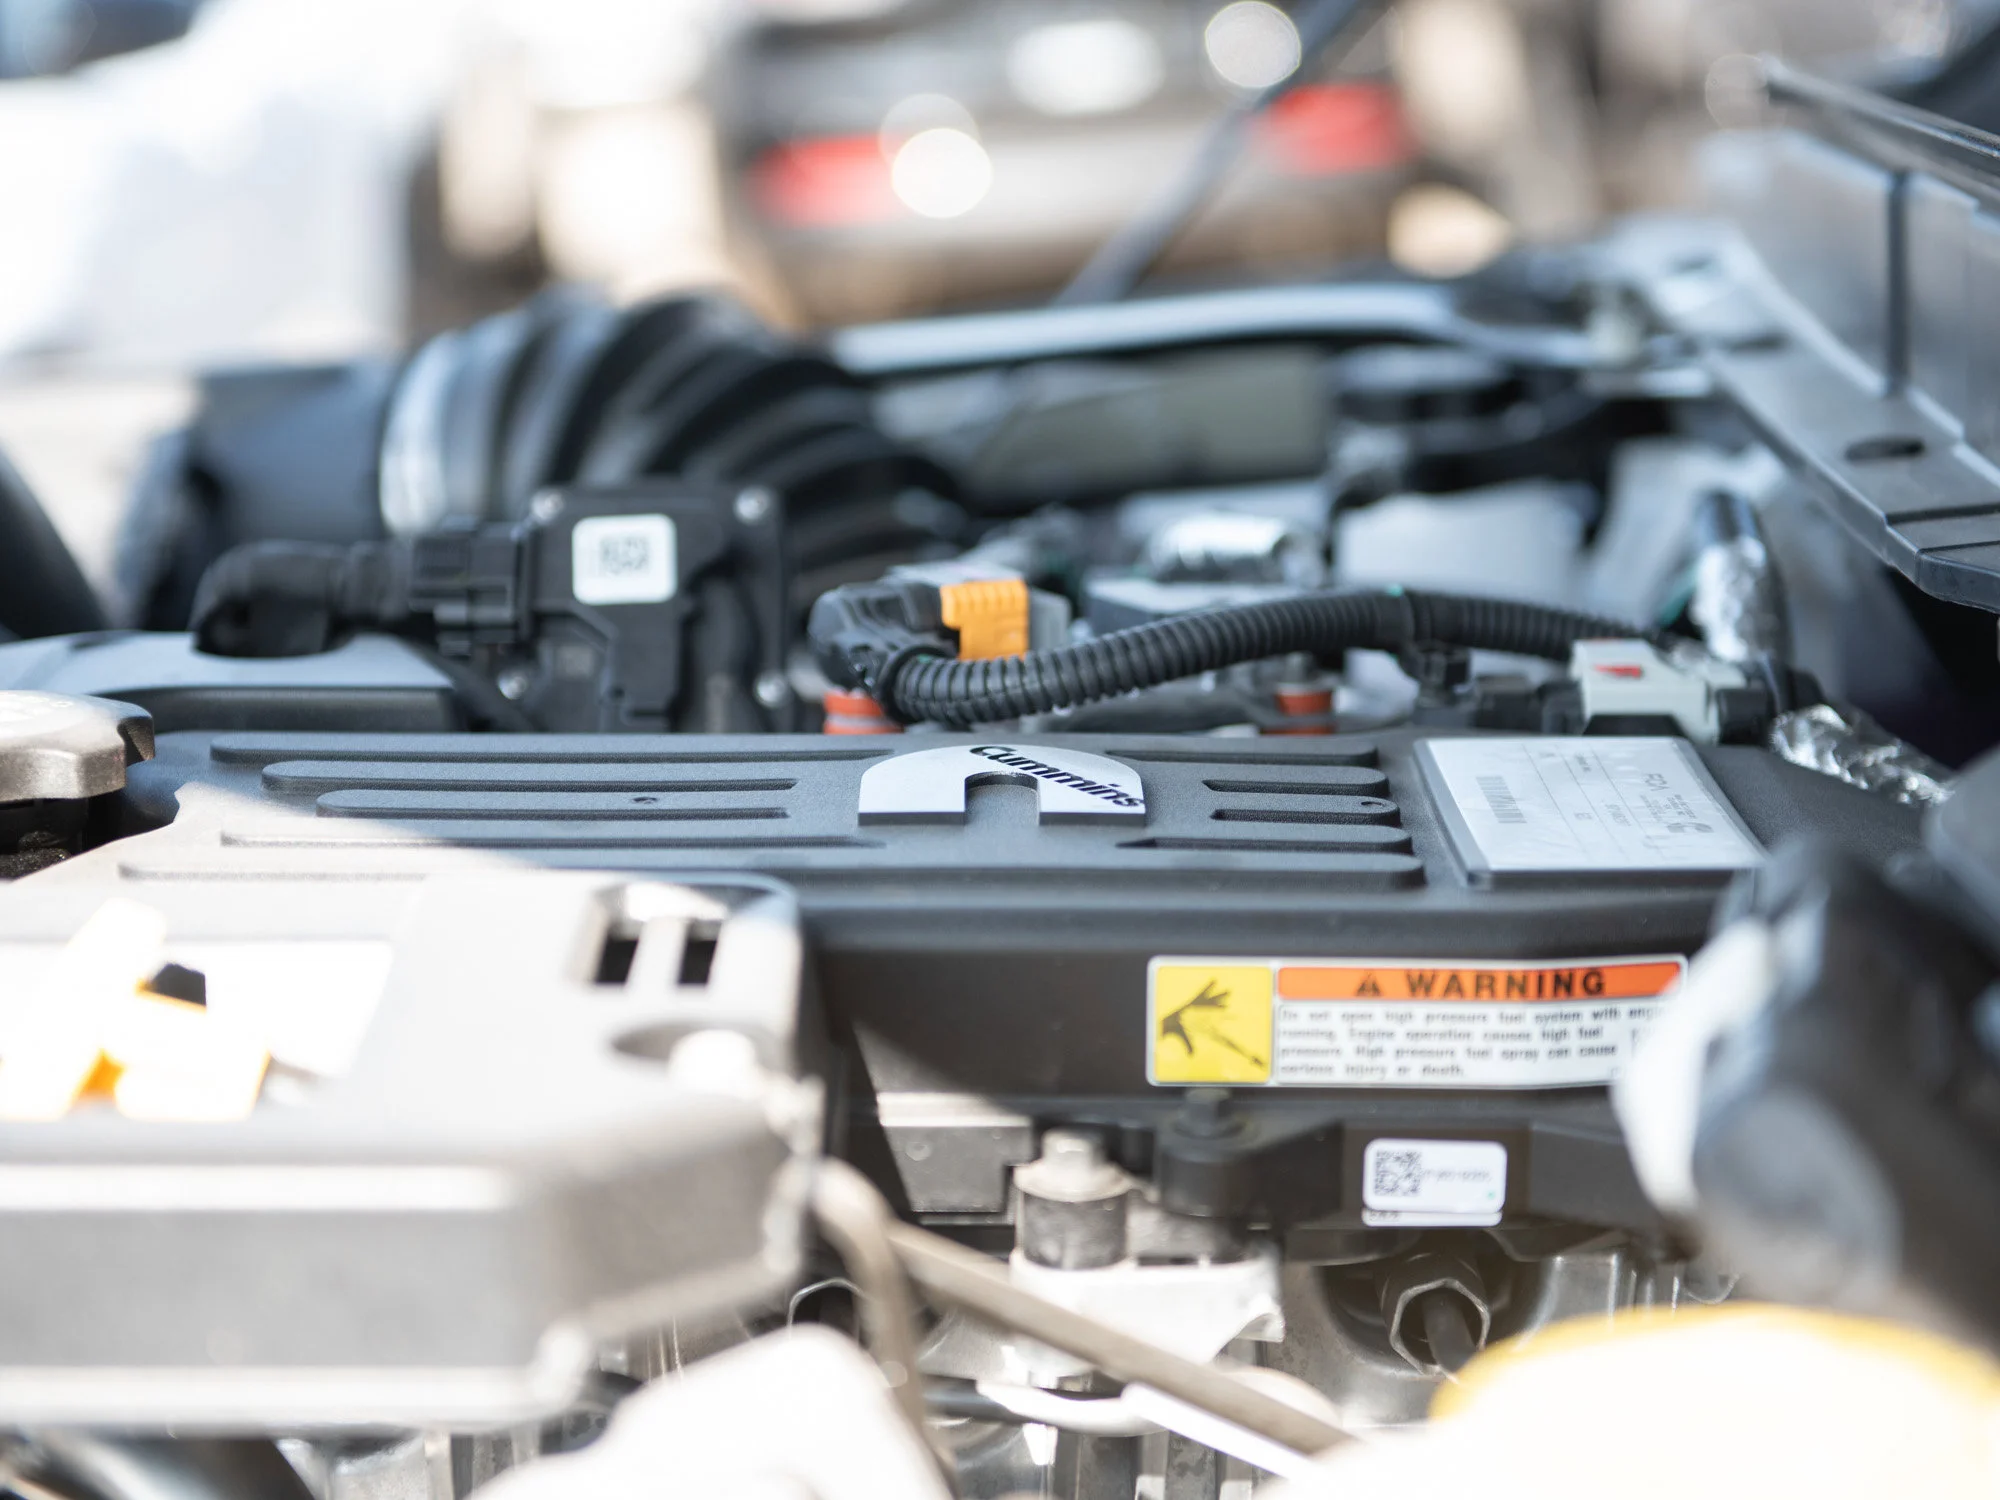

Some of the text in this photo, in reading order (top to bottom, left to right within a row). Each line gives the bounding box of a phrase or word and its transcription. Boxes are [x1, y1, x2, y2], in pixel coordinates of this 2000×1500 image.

[970, 745, 1146, 807] Cummins
[1407, 969, 1605, 998] WARNING
[1425, 1010, 1488, 1025] pressure
[1499, 1009, 1525, 1023] fuel
[1535, 1009, 1581, 1025] system
[1592, 1007, 1620, 1021] with
[1349, 1028, 1395, 1044] Engine
[1405, 1028, 1472, 1043] operation
[1483, 1029, 1532, 1041] causes
[1541, 1026, 1569, 1042] high
[1578, 1025, 1604, 1039] fuel
[1395, 1047, 1455, 1061] pressure
[1466, 1045, 1492, 1059] fuel
[1501, 1046, 1540, 1061] spray
[1548, 1045, 1570, 1057] can
[1580, 1044, 1617, 1057] cause
[1345, 1063, 1388, 1078] injury
[1396, 1064, 1411, 1075] or
